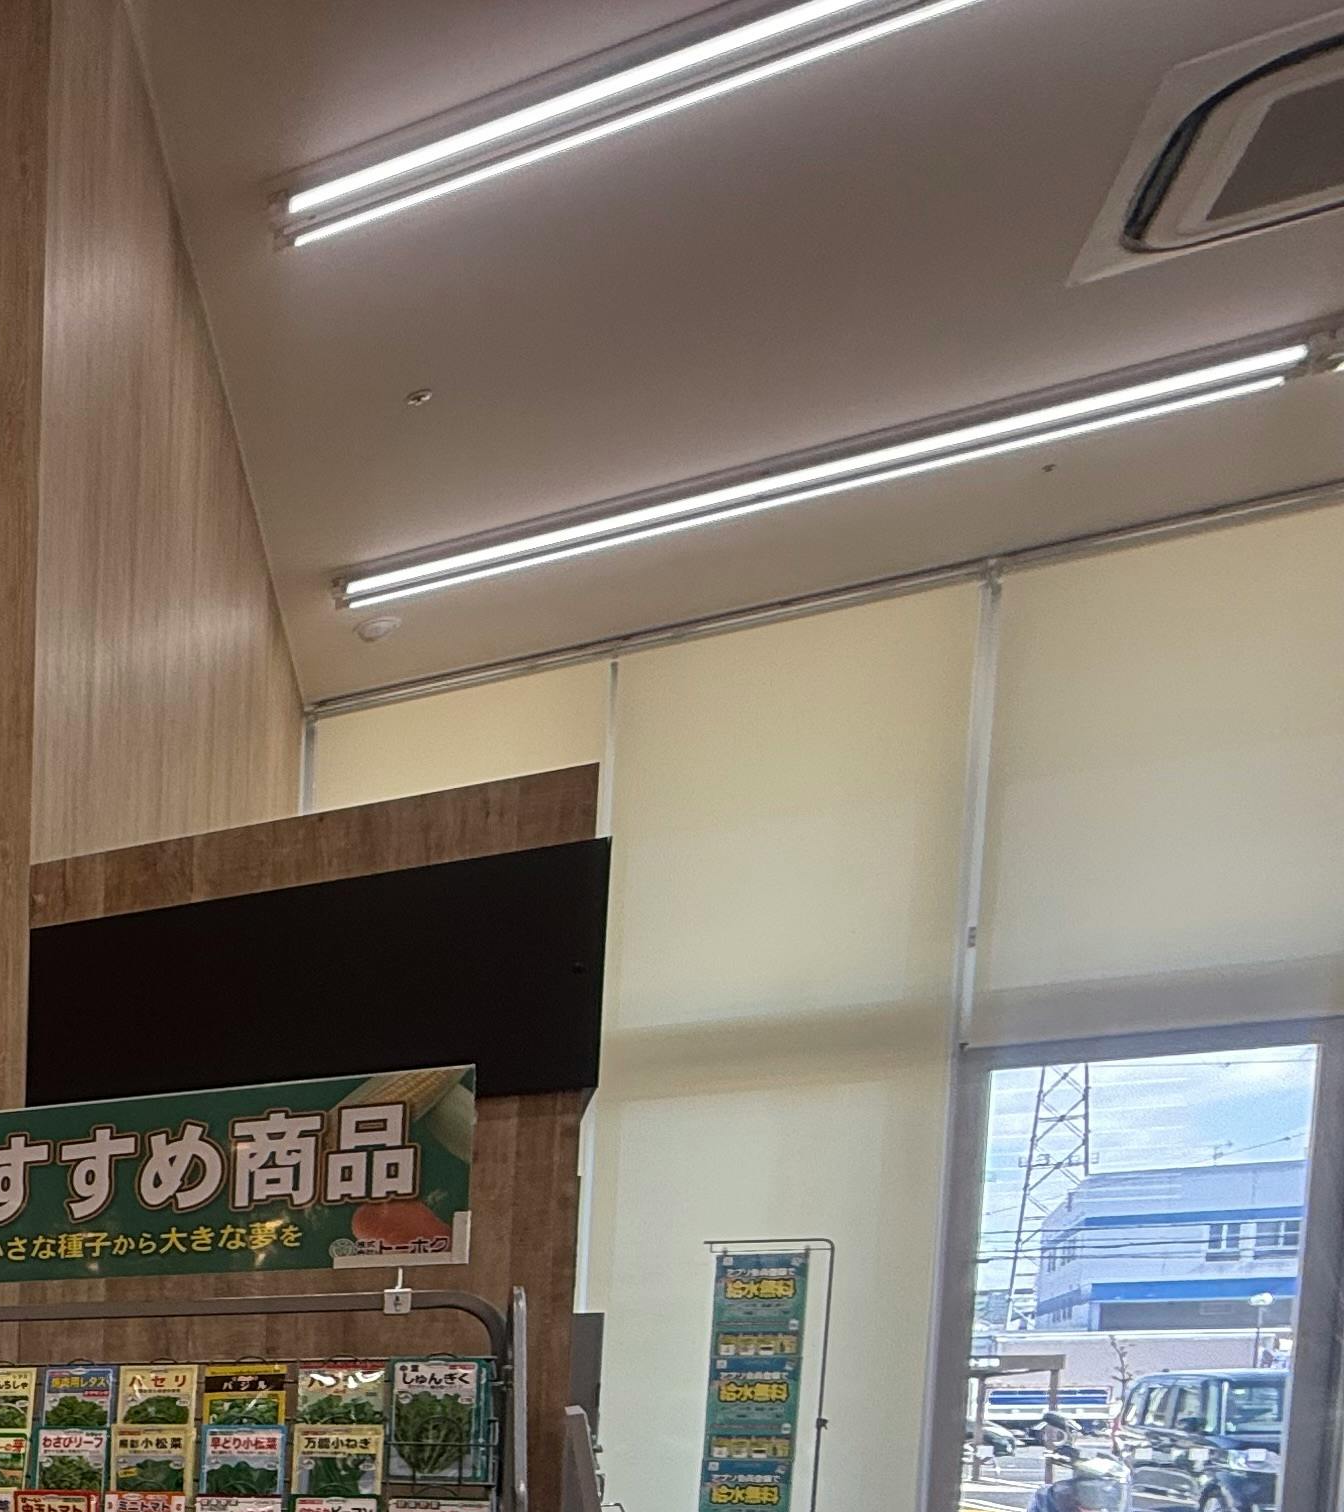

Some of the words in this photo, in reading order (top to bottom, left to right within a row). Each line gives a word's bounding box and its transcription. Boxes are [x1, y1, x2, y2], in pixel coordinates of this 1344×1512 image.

[402, 1372, 470, 1385] しゅんぎく
[304, 1438, 372, 1449] 万能小ねぎ
[118, 1501, 170, 1512] ミニトマト
